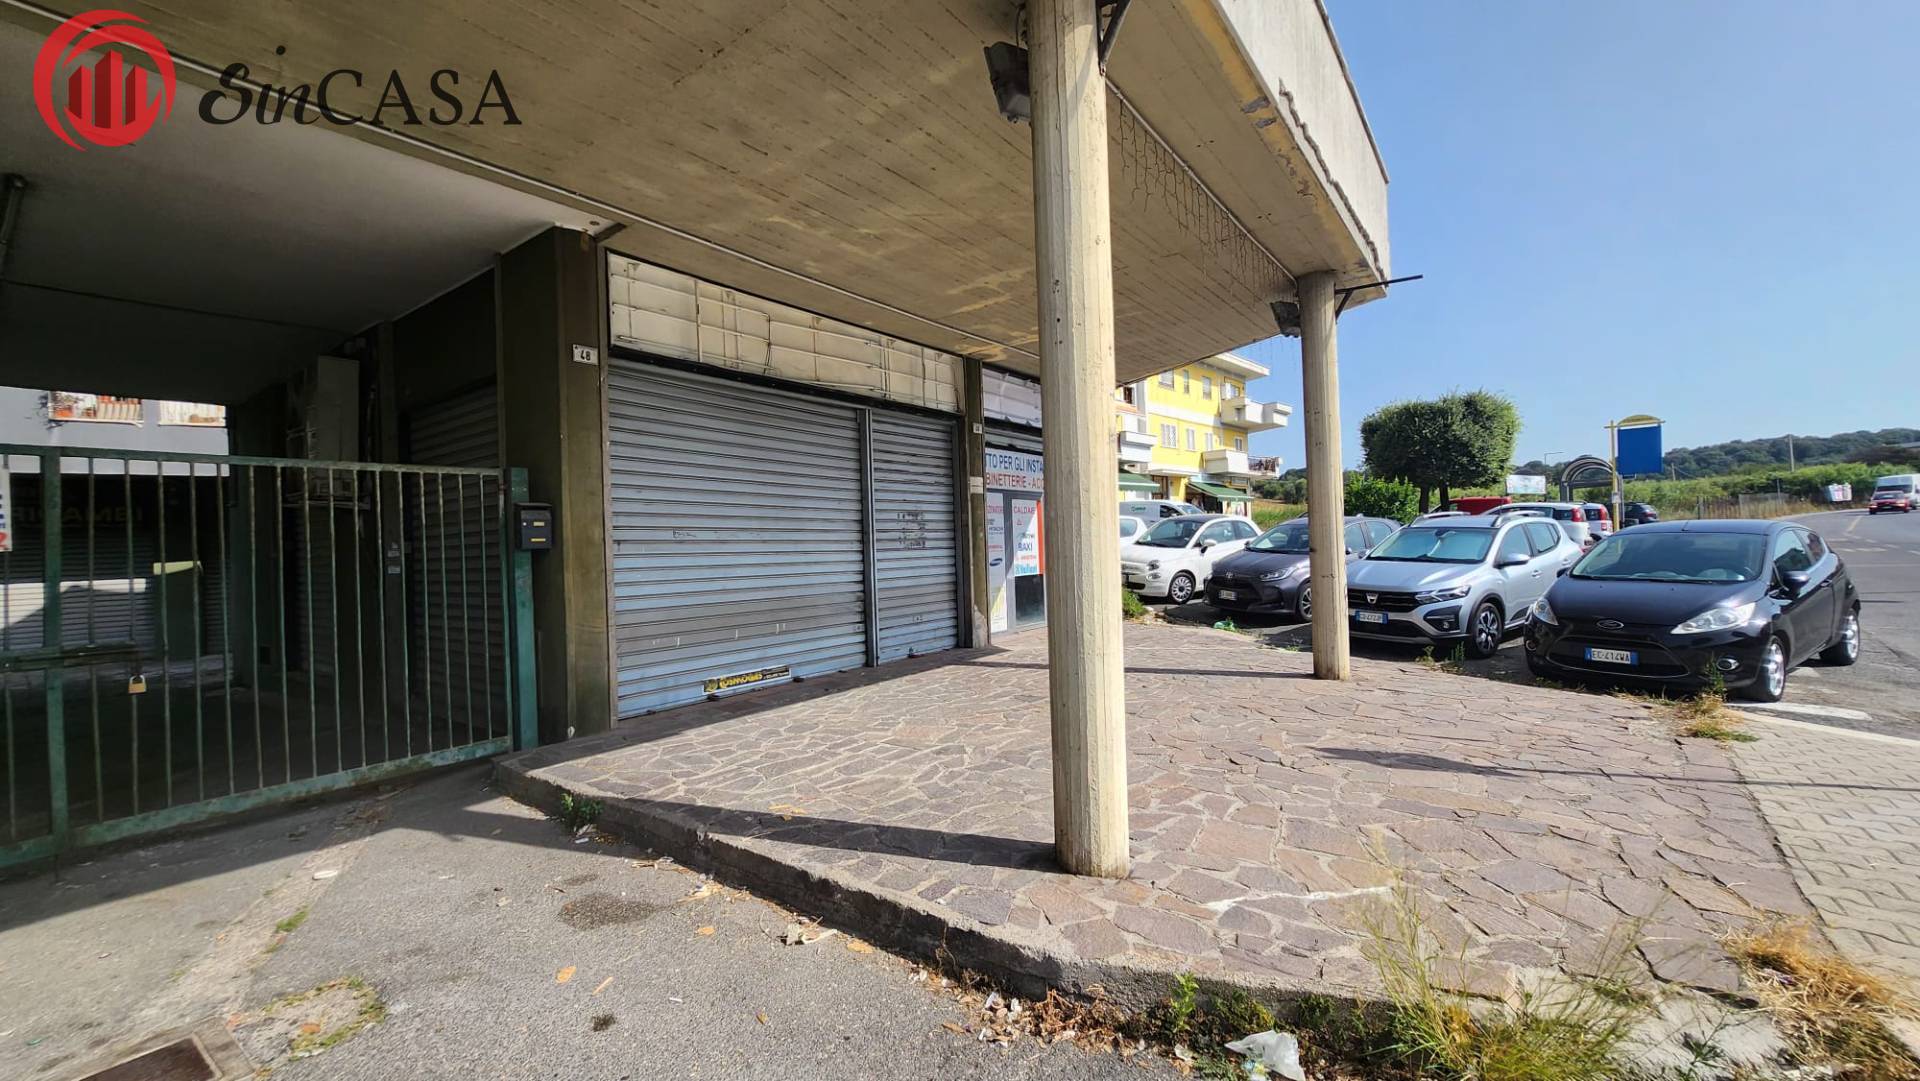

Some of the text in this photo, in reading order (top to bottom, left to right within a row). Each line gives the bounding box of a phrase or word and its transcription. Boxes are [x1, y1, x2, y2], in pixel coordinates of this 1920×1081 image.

[580, 350, 591, 361] 48
[999, 455, 1013, 470] PER
[1015, 457, 1024, 471] GLI
[986, 473, 1026, 488] BINETTERIE
